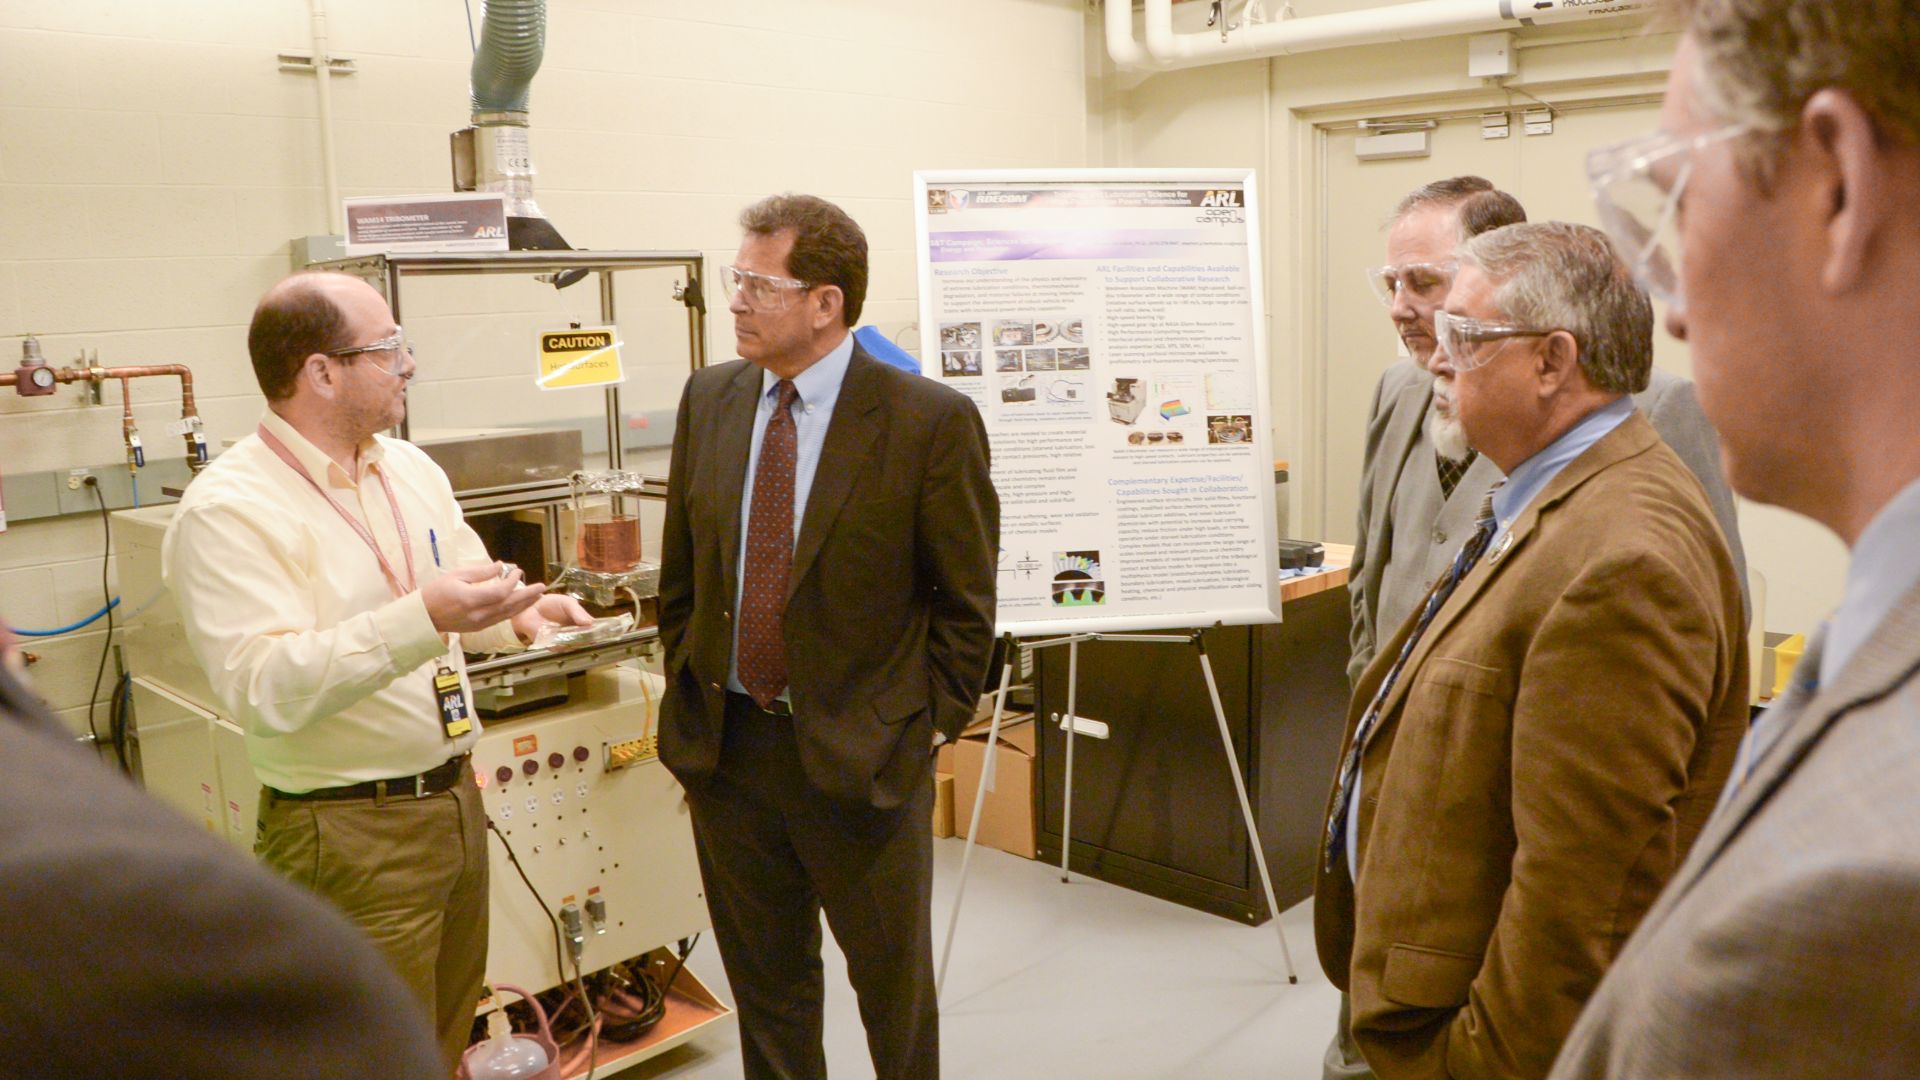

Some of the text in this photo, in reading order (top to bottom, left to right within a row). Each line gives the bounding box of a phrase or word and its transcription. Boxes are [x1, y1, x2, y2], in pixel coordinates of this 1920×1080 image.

[976, 194, 1028, 204] RDECOM
[1200, 190, 1241, 207] ARL
[385, 214, 430, 223] TRIBOMETER
[1196, 216, 1245, 227] campus
[474, 226, 504, 238] ARL
[934, 266, 1008, 277] Research Objective
[1096, 264, 1240, 275] ARL Facilities and Capabilities Available
[1105, 274, 1230, 285] to Support Collaborative Research
[548, 336, 606, 349] CAUTION
[574, 360, 609, 370] urfaces
[1108, 475, 1167, 487] Complementary
[1117, 484, 1248, 498] Capabilities Sought in Collaboration
[444, 694, 464, 712] ARL
